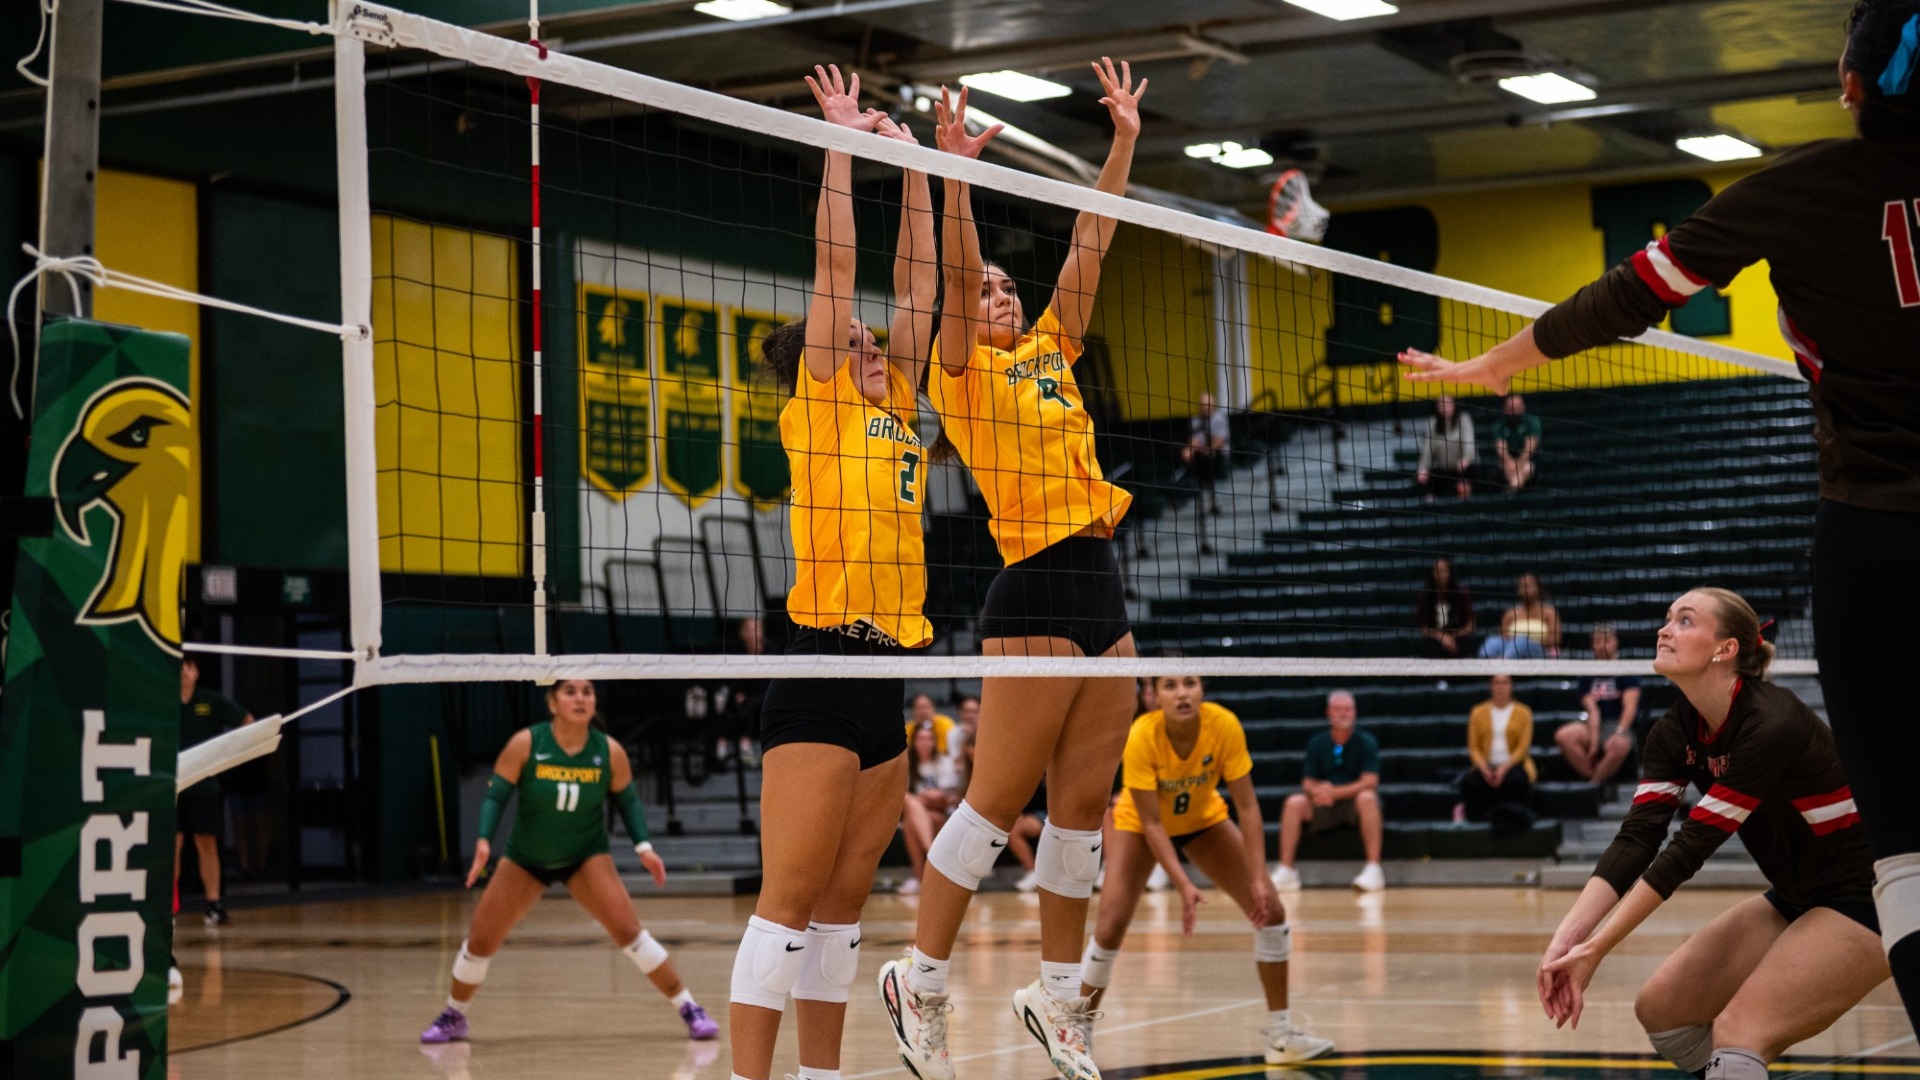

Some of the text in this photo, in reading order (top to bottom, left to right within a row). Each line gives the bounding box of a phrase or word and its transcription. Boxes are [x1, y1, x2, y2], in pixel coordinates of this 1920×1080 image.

[1881, 198, 1920, 307] 1
[899, 449, 920, 505] 2
[536, 764, 602, 783] BROCKPORT
[556, 782, 580, 812] 11
[1173, 791, 1191, 816] 8
